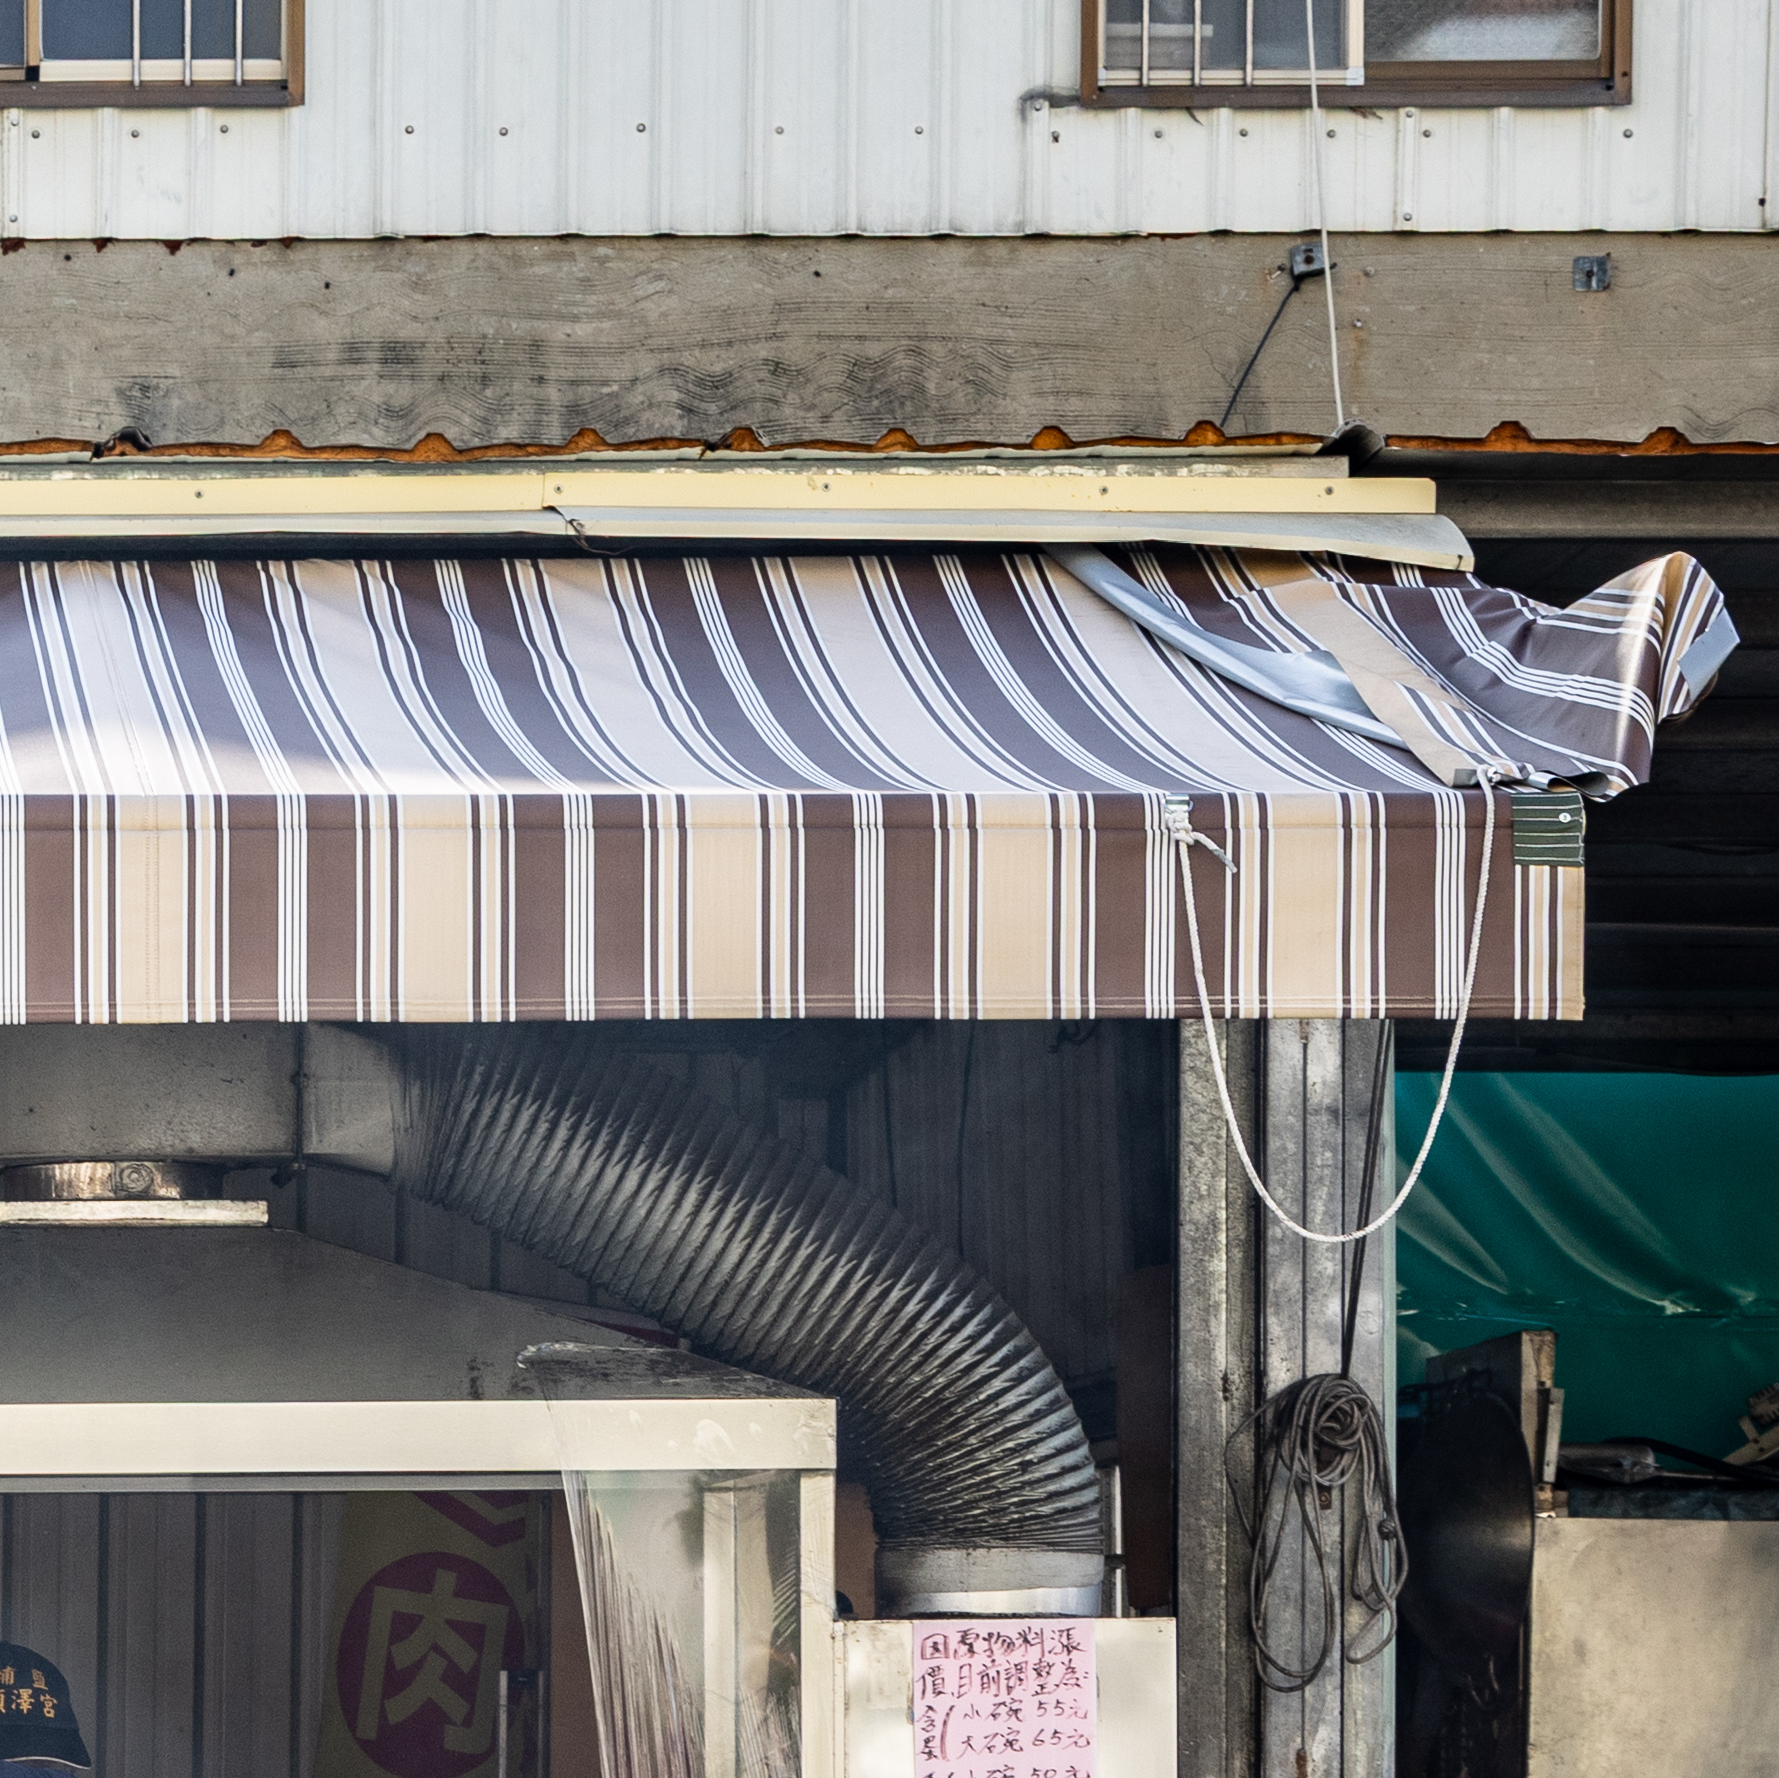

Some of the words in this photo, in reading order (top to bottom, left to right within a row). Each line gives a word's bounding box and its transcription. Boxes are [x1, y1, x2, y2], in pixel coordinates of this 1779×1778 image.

[920, 1626, 1089, 1661] 因原物料漲
